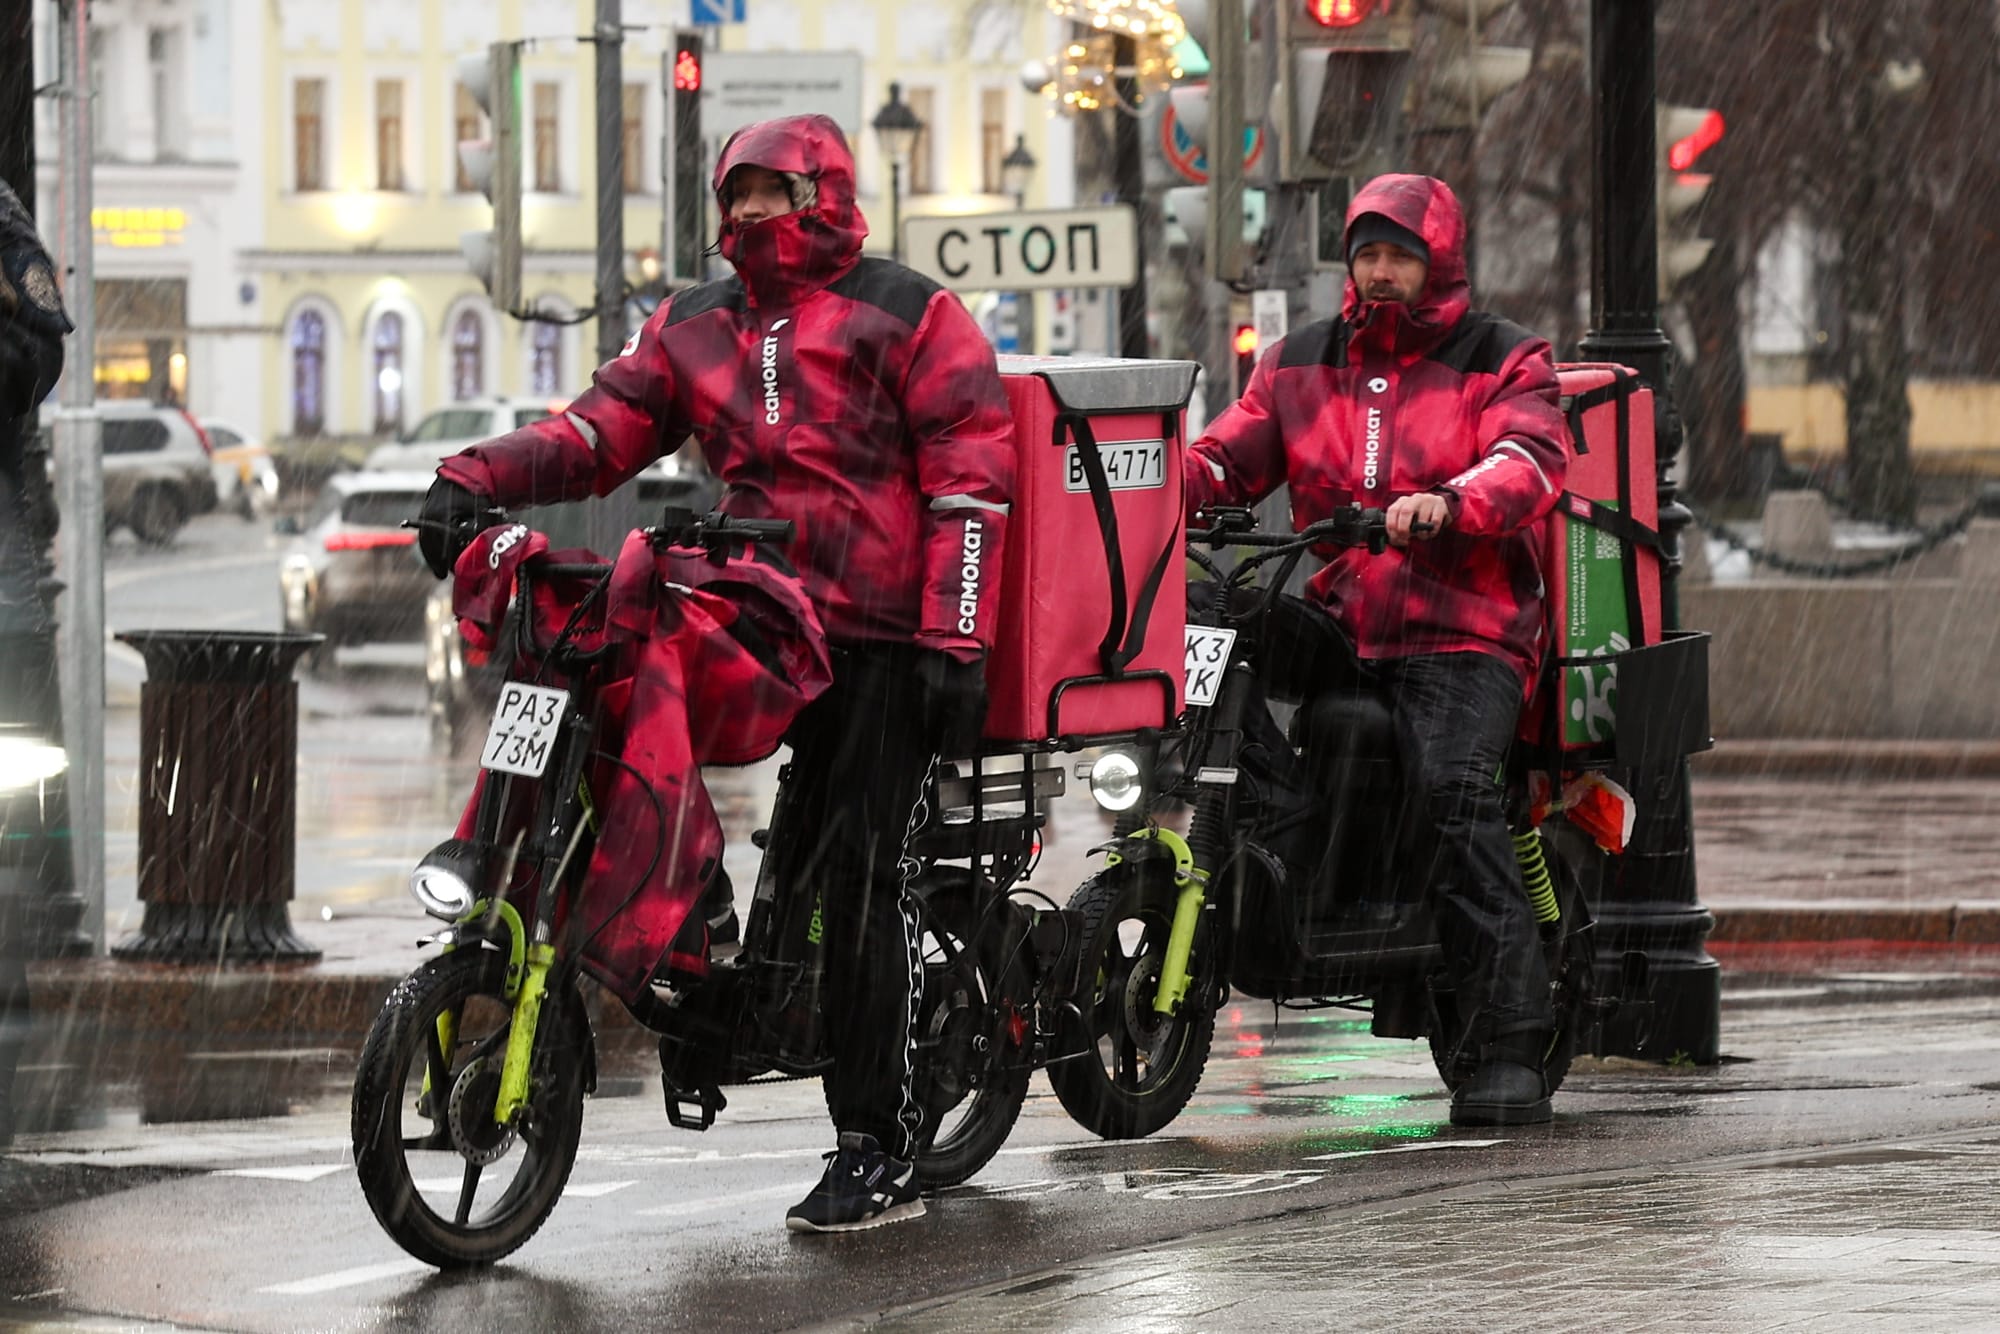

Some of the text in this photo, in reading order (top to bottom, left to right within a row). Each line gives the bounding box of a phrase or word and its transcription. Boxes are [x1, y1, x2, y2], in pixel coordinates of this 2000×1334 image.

[937, 223, 1099, 279] СТОП
[1069, 447, 1162, 485] В4771
[957, 519, 983, 635] самокат
[501, 689, 560, 726] РА3
[491, 732, 548, 770] 73М
